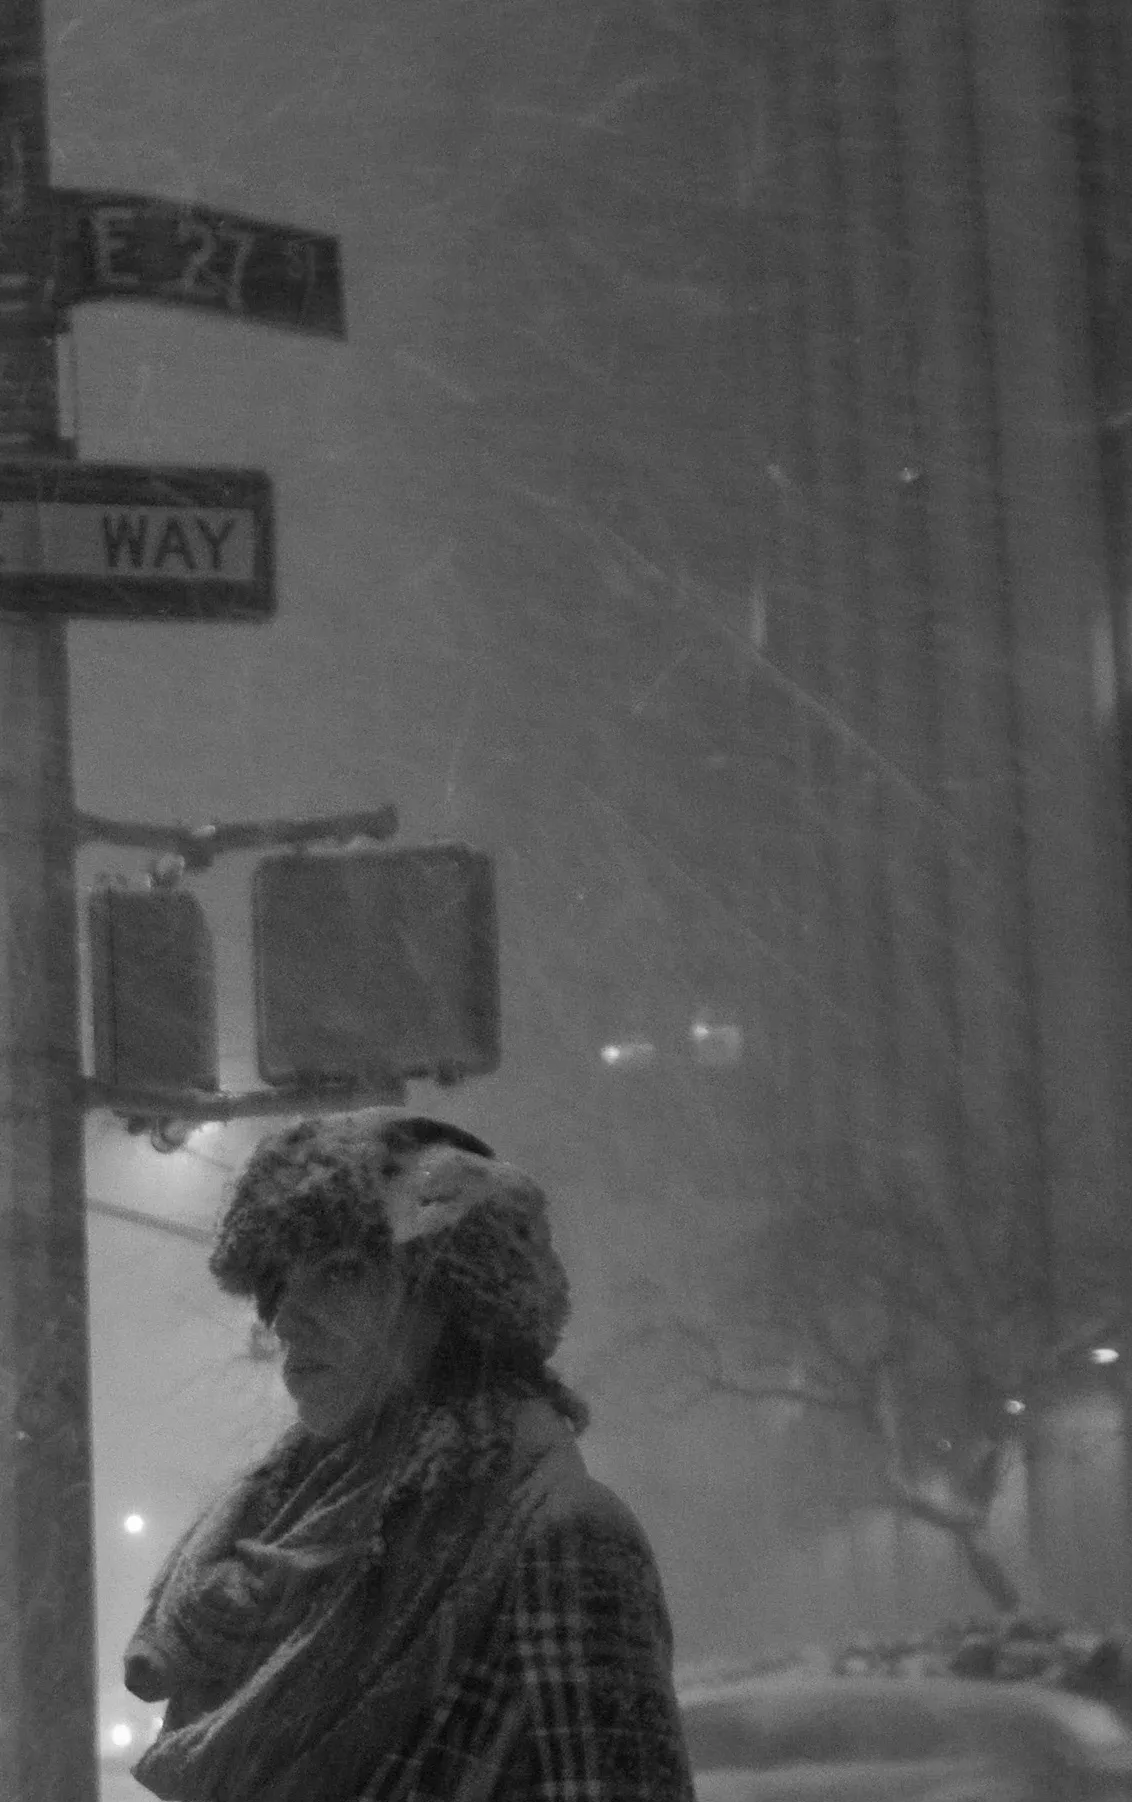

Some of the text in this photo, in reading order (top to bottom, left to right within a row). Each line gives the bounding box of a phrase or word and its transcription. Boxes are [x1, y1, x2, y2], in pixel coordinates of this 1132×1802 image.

[92, 206, 139, 285] E
[176, 219, 257, 312] 27
[101, 513, 237, 570] WAY
